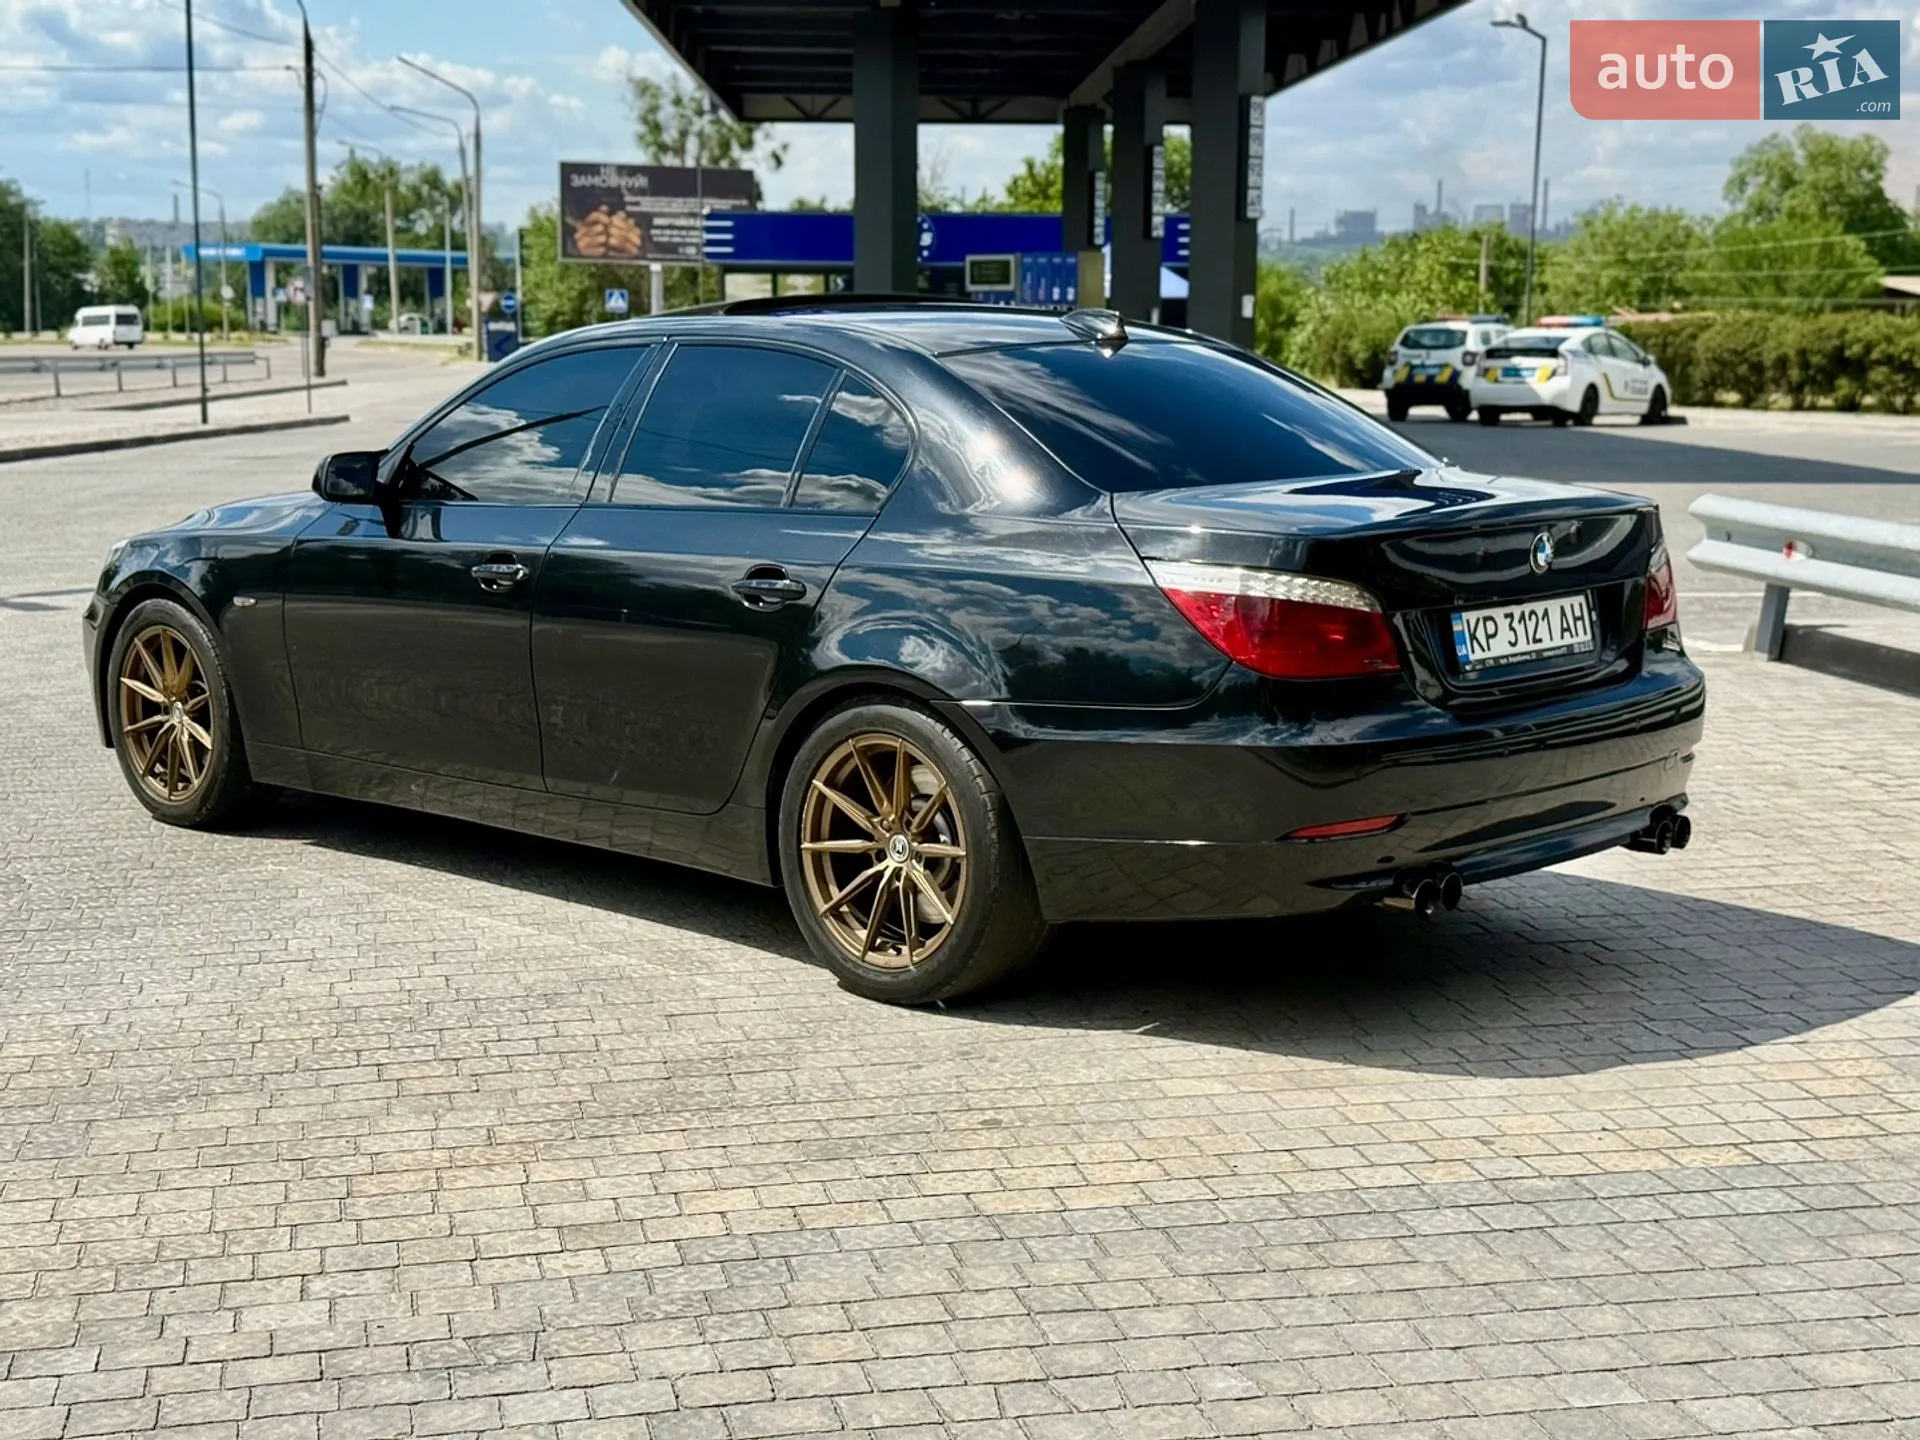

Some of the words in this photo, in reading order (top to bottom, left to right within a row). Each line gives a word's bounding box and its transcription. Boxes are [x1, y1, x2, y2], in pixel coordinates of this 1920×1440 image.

[1466, 614, 1499, 655] KP
[1503, 607, 1554, 648] 3121
[1560, 601, 1588, 640] AH
[1456, 643, 1468, 657] UA
